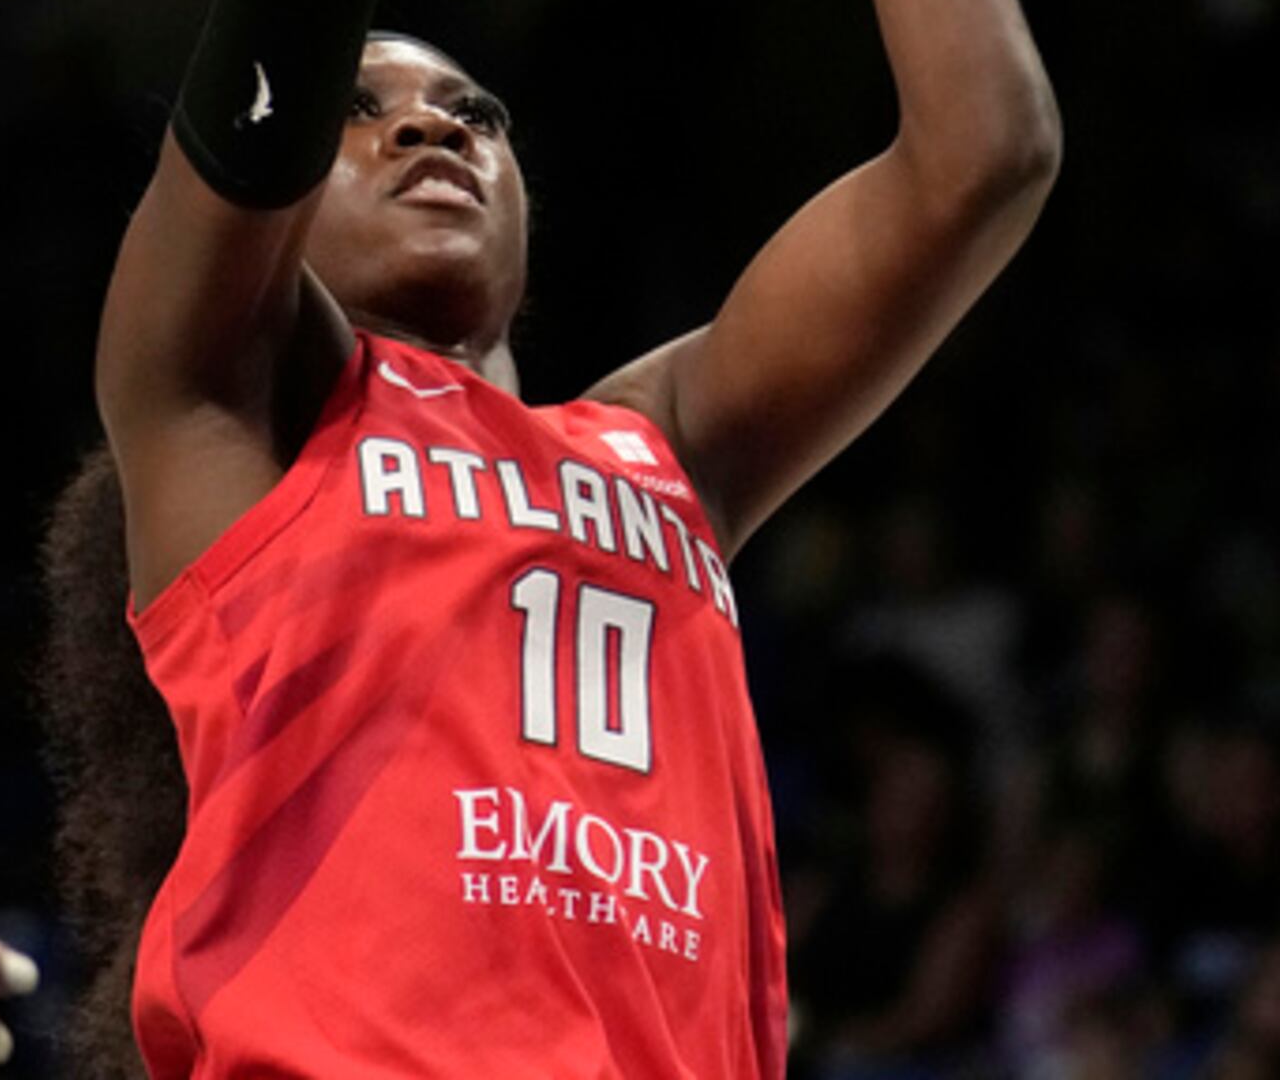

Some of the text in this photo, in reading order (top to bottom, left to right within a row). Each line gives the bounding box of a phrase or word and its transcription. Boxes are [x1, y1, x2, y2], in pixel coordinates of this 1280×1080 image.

[357, 435, 740, 630] ATLANTA
[510, 565, 656, 776] 10
[452, 786, 711, 920] EMORY
[460, 871, 702, 963] HEATHARE
